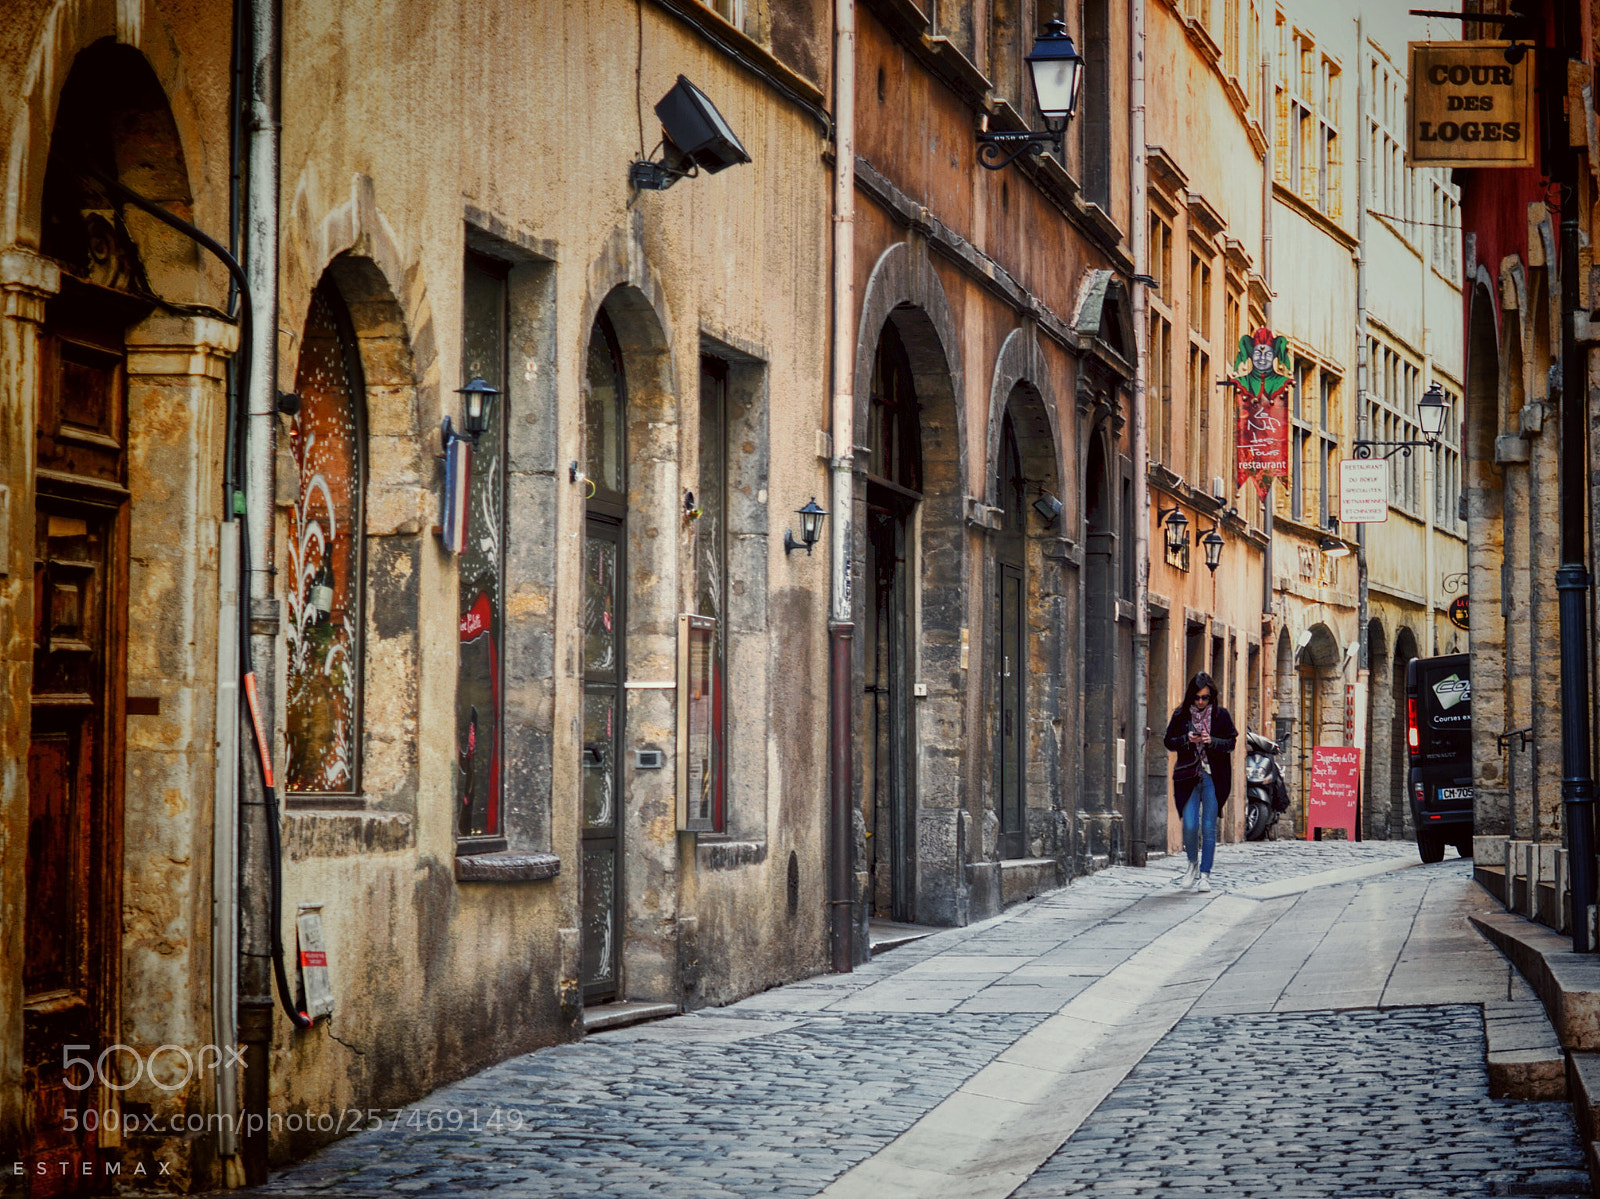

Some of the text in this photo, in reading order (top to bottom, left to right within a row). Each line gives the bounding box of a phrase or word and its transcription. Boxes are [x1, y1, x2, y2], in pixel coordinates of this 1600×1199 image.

[1428, 65, 1513, 85] COUR
[1447, 96, 1493, 111] DES
[1419, 122, 1521, 142] LOGES
[1238, 460, 1287, 469] restaurant
[1433, 714, 1461, 723] Courses
